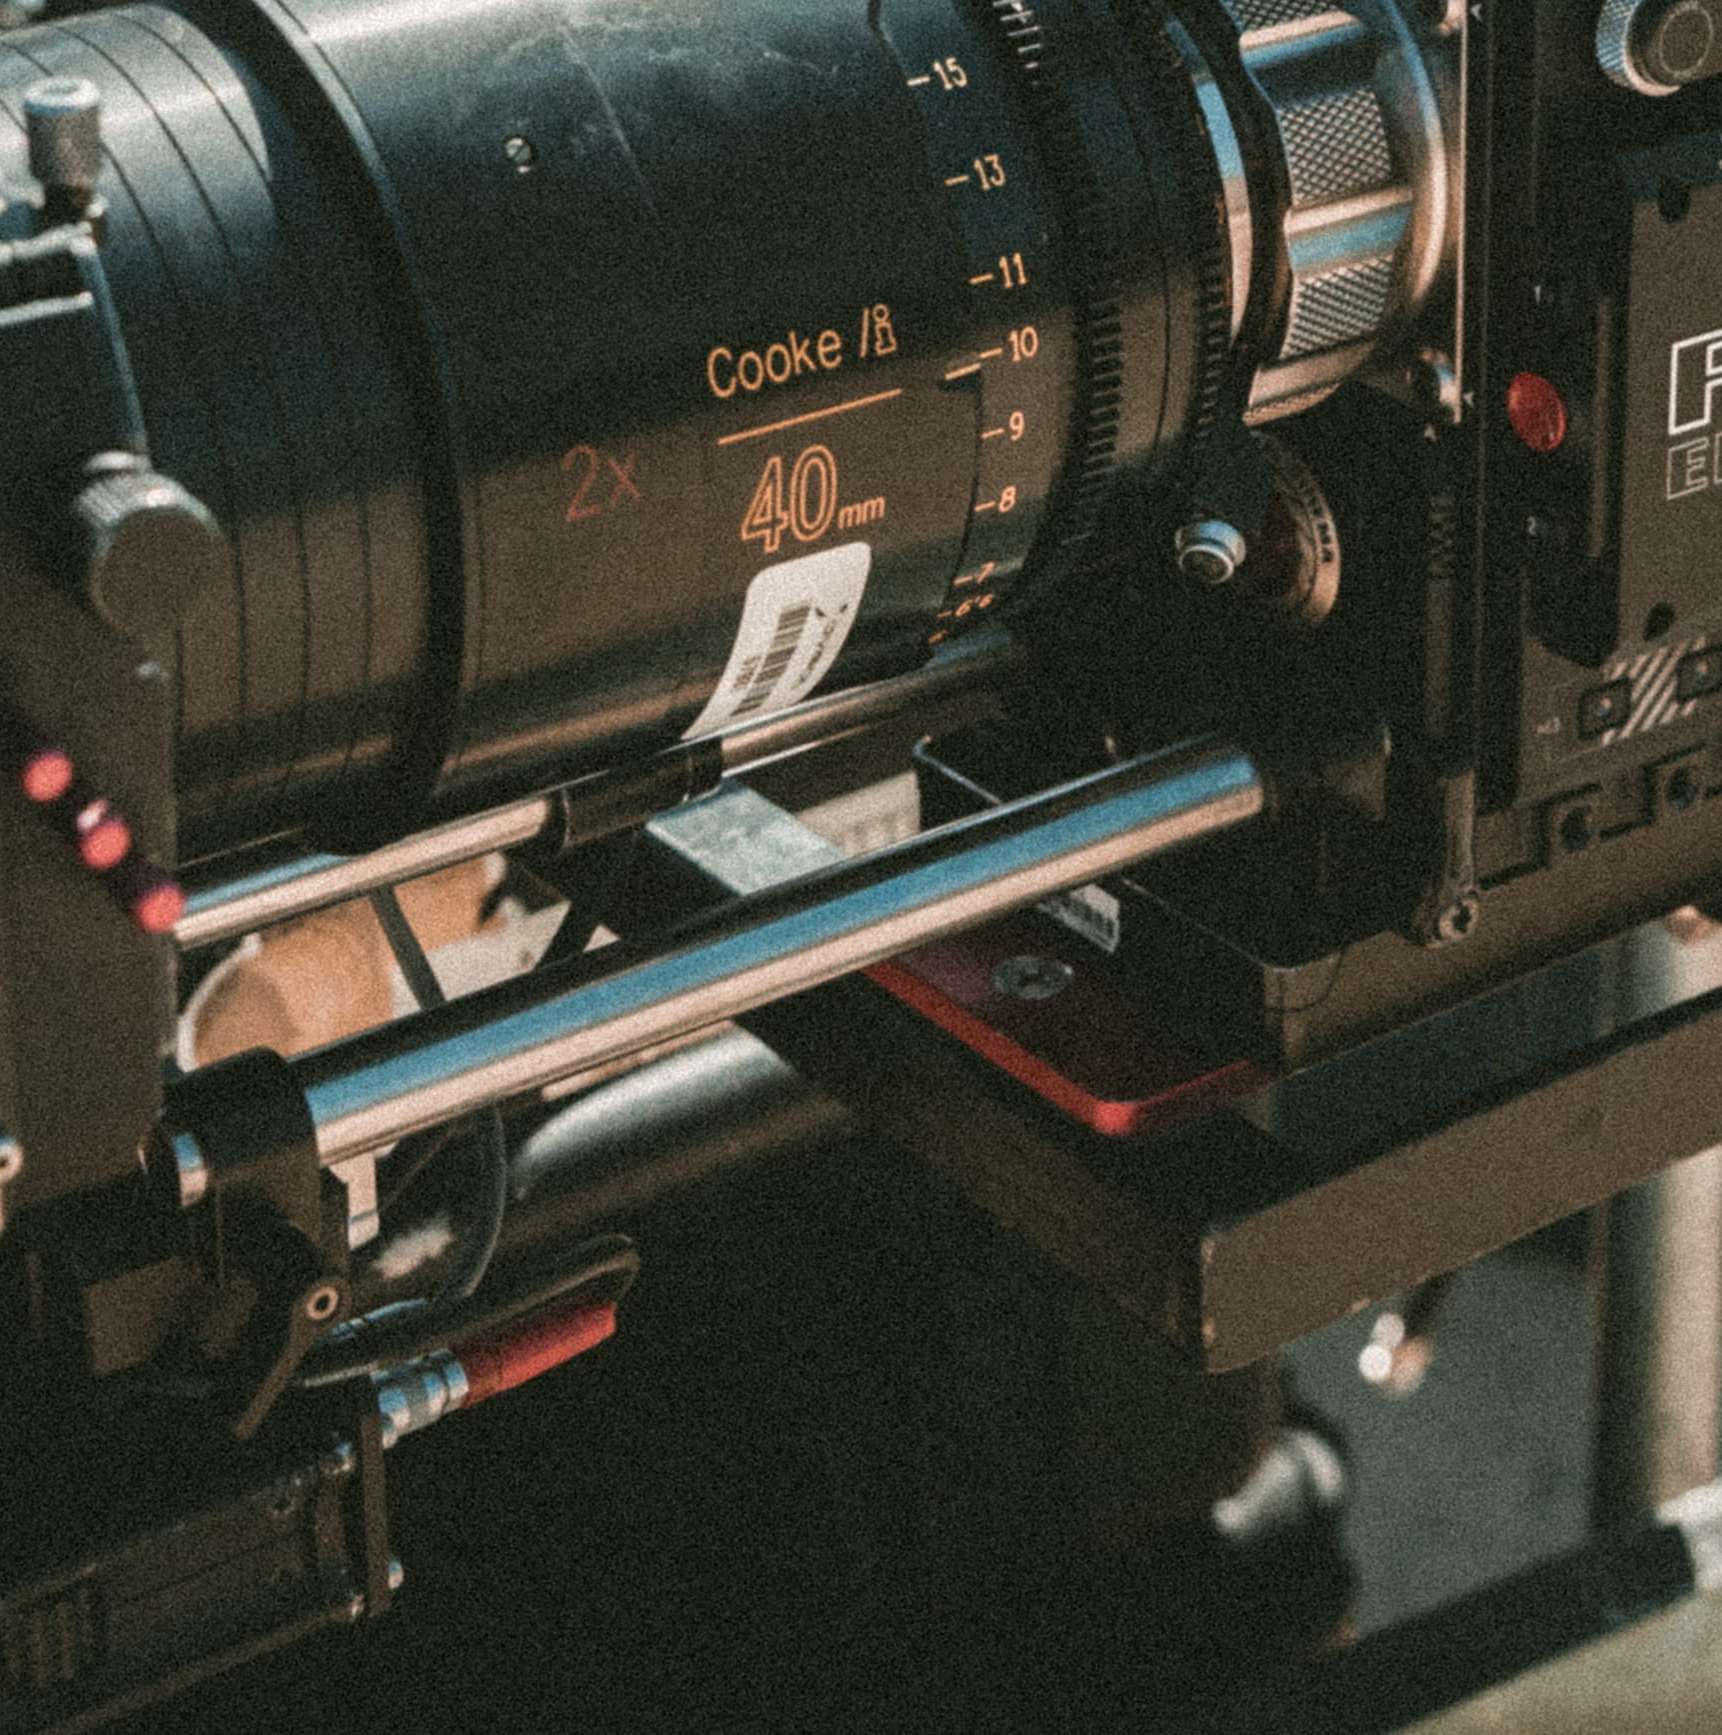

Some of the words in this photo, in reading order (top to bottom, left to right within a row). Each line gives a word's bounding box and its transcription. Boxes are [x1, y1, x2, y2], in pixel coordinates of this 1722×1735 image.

[932, 56, 969, 92] 15
[973, 153, 1007, 192] 13
[998, 252, 1029, 289] 11
[706, 327, 843, 399] Cooke
[1009, 327, 1040, 364] 10
[1009, 412, 1026, 441] 9
[998, 486, 1017, 513] 8
